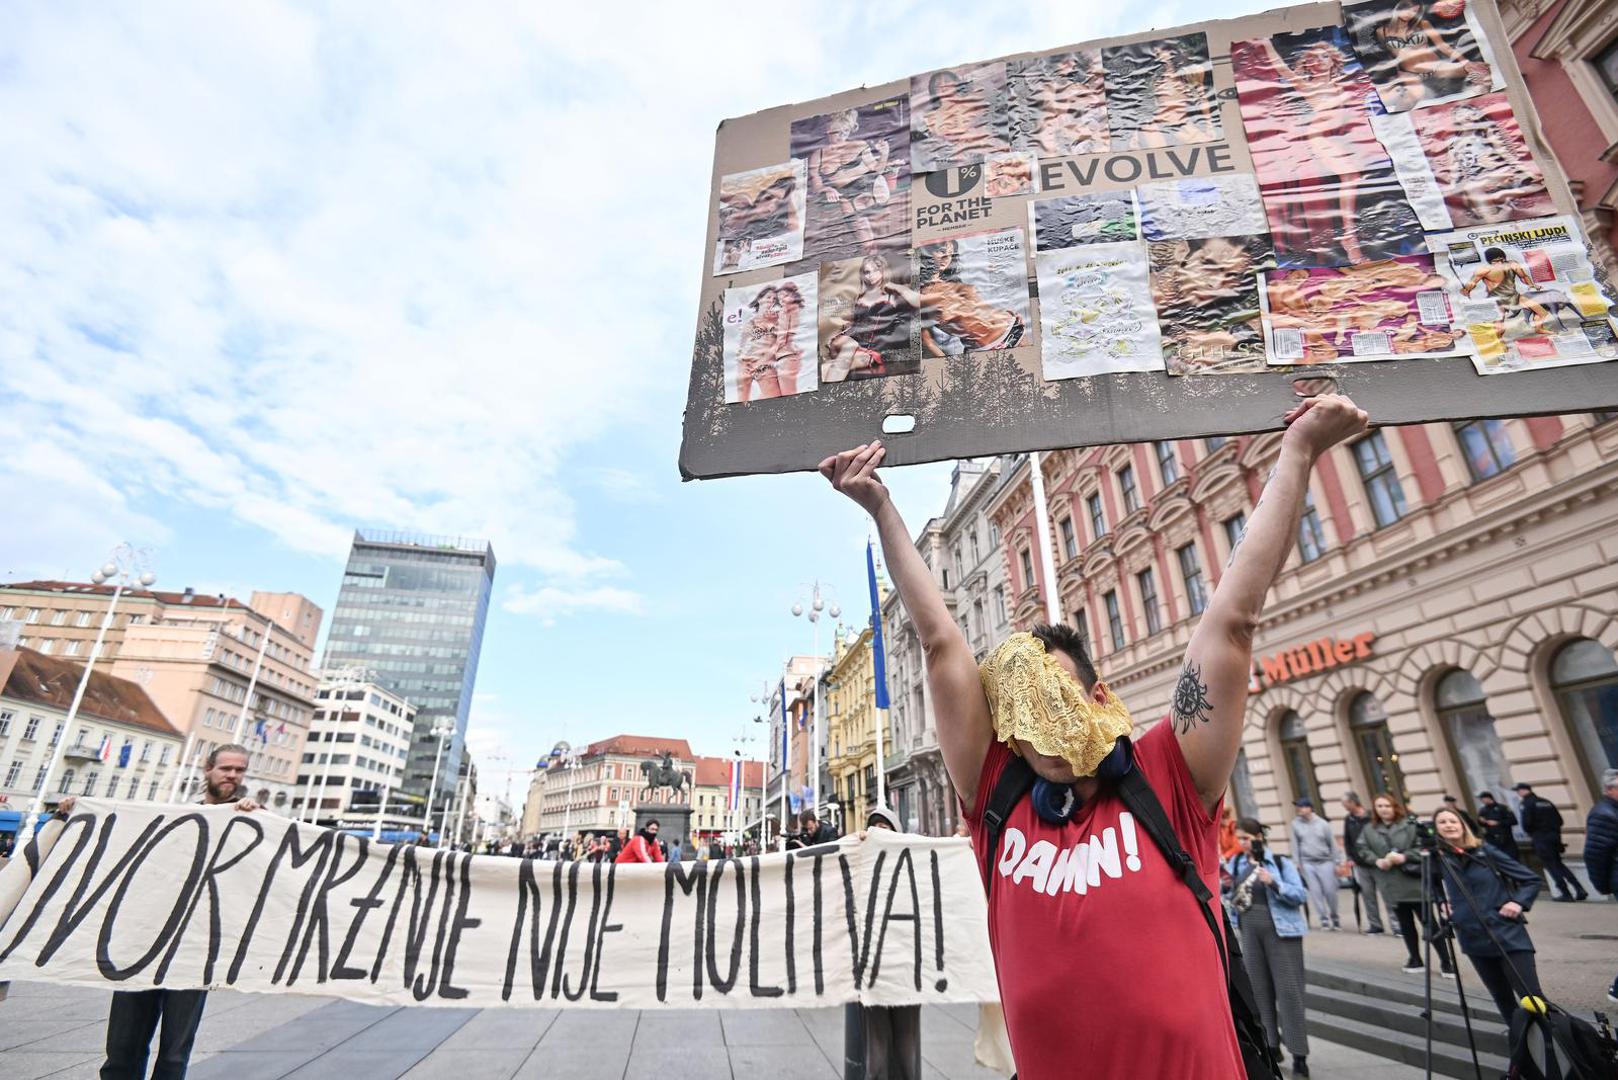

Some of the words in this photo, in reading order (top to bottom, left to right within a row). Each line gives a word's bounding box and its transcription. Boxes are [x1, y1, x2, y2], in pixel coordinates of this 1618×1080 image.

[1041, 144, 1236, 192] EVOLVE
[916, 201, 953, 217] FOR
[956, 195, 993, 210] THE
[916, 206, 993, 229] PLANET
[1534, 225, 1569, 238] LJUDI
[1260, 630, 1376, 688] Müller
[998, 811, 1142, 897] DAMN!
[501, 858, 624, 1002] NIJE
[655, 843, 950, 1002] MOLITVA!
